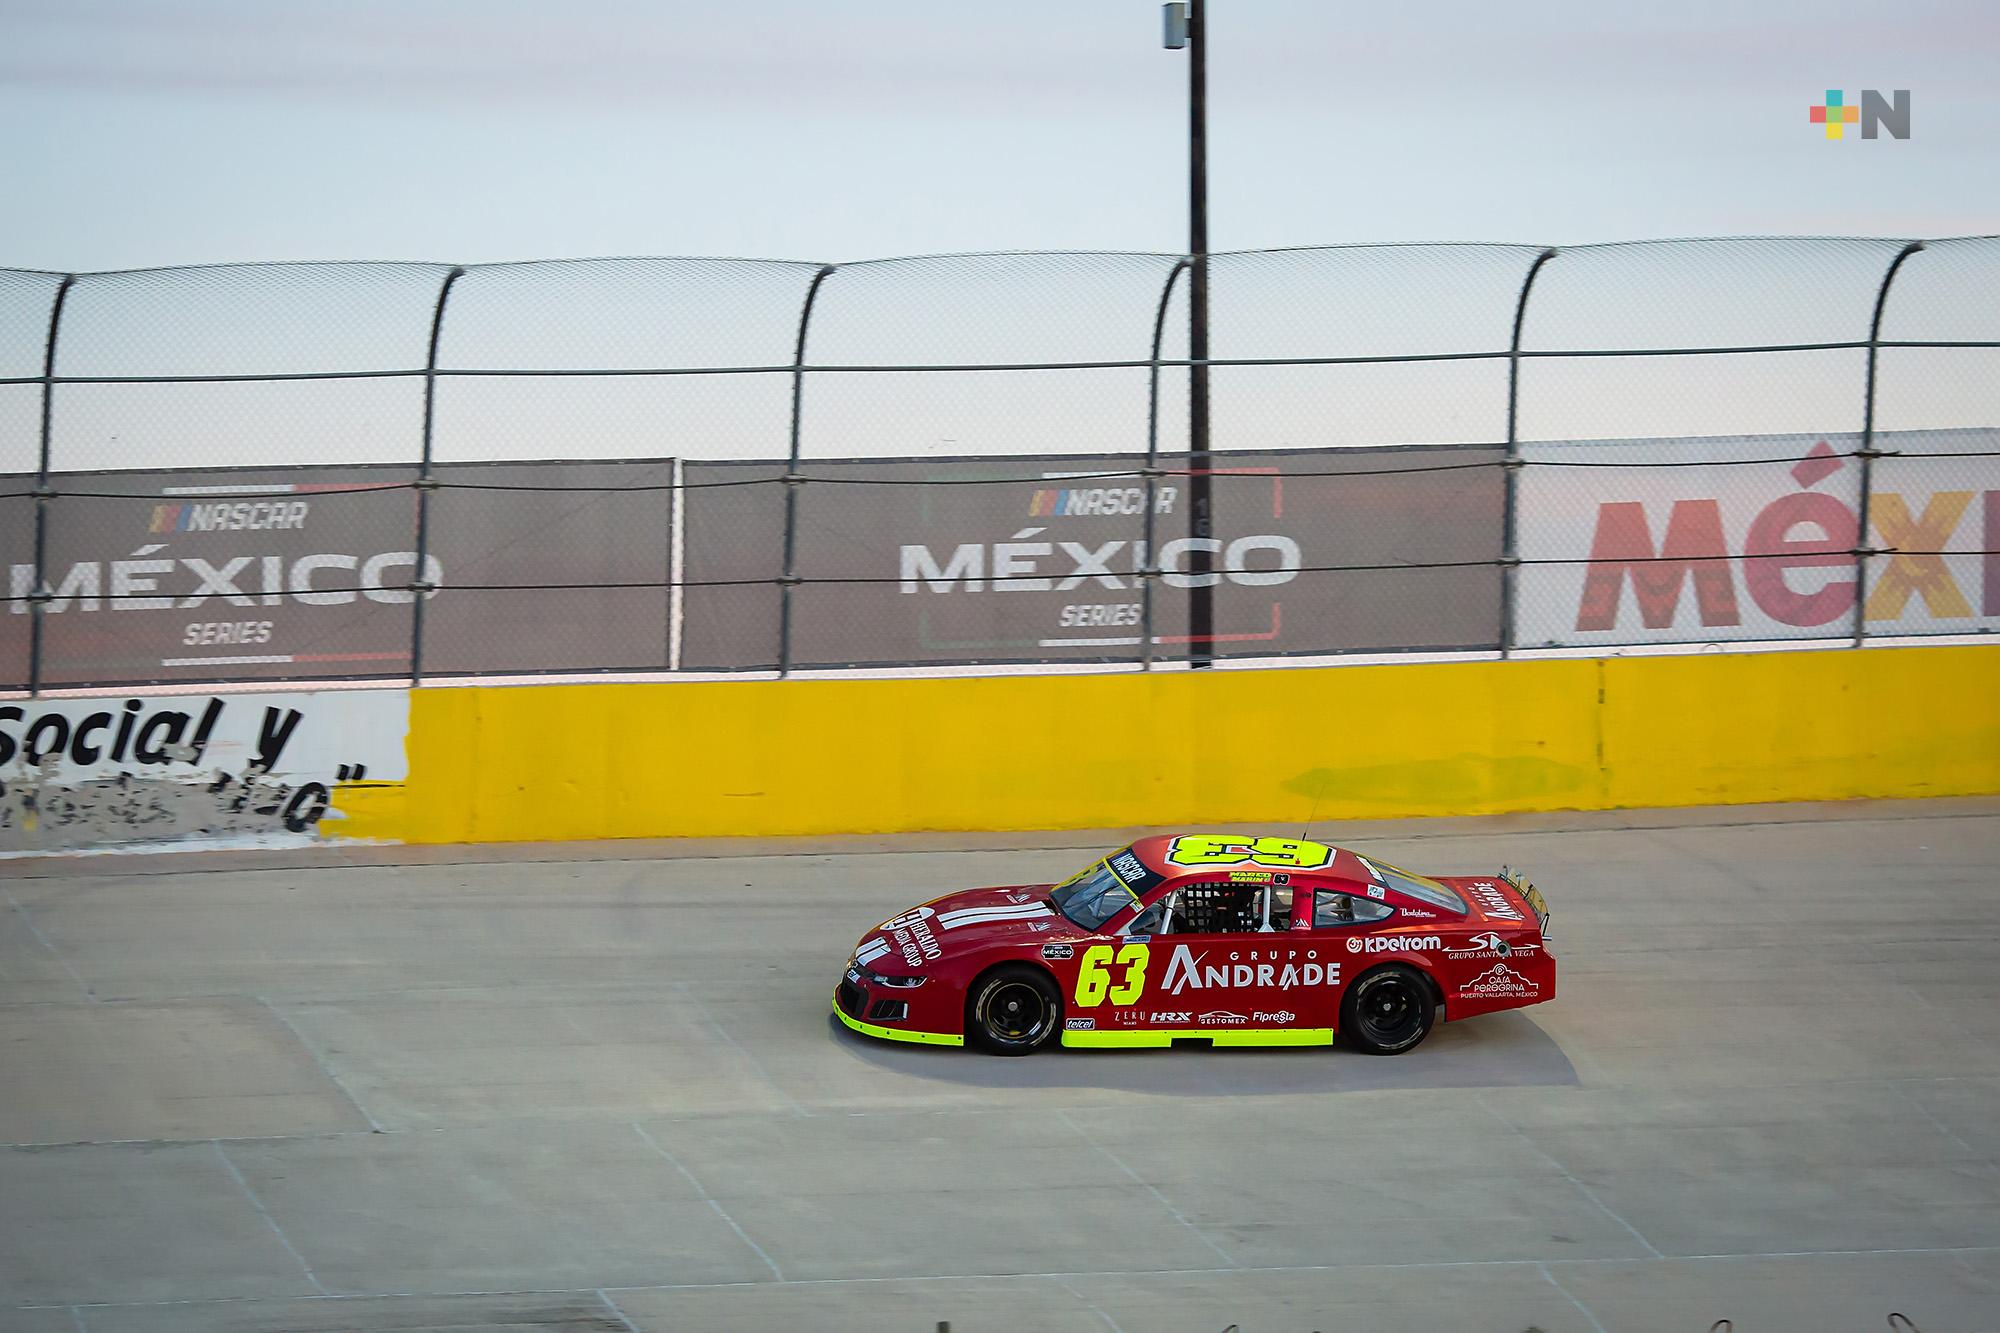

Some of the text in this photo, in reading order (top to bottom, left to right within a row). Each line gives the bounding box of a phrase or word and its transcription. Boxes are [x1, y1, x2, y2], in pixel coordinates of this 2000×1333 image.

[187, 501, 308, 531] NASCAR
[10, 544, 443, 615] MÉXICO
[1059, 604, 1143, 628] SERIES
[183, 621, 274, 647] SERIES
[247, 706, 303, 774] y
[1164, 834, 1338, 871] 63
[910, 920, 942, 960] HERALDO
[1448, 951, 1475, 959] GRUPO
[1515, 949, 1535, 957] VEGA
[902, 943, 923, 967] GROUP
[1229, 951, 1317, 961] GRUPO
[1075, 943, 1150, 1007] 63
[1161, 944, 1341, 995] ANDRADE
[1067, 1019, 1093, 1029] telcel
[1150, 1011, 1193, 1022] HRX
